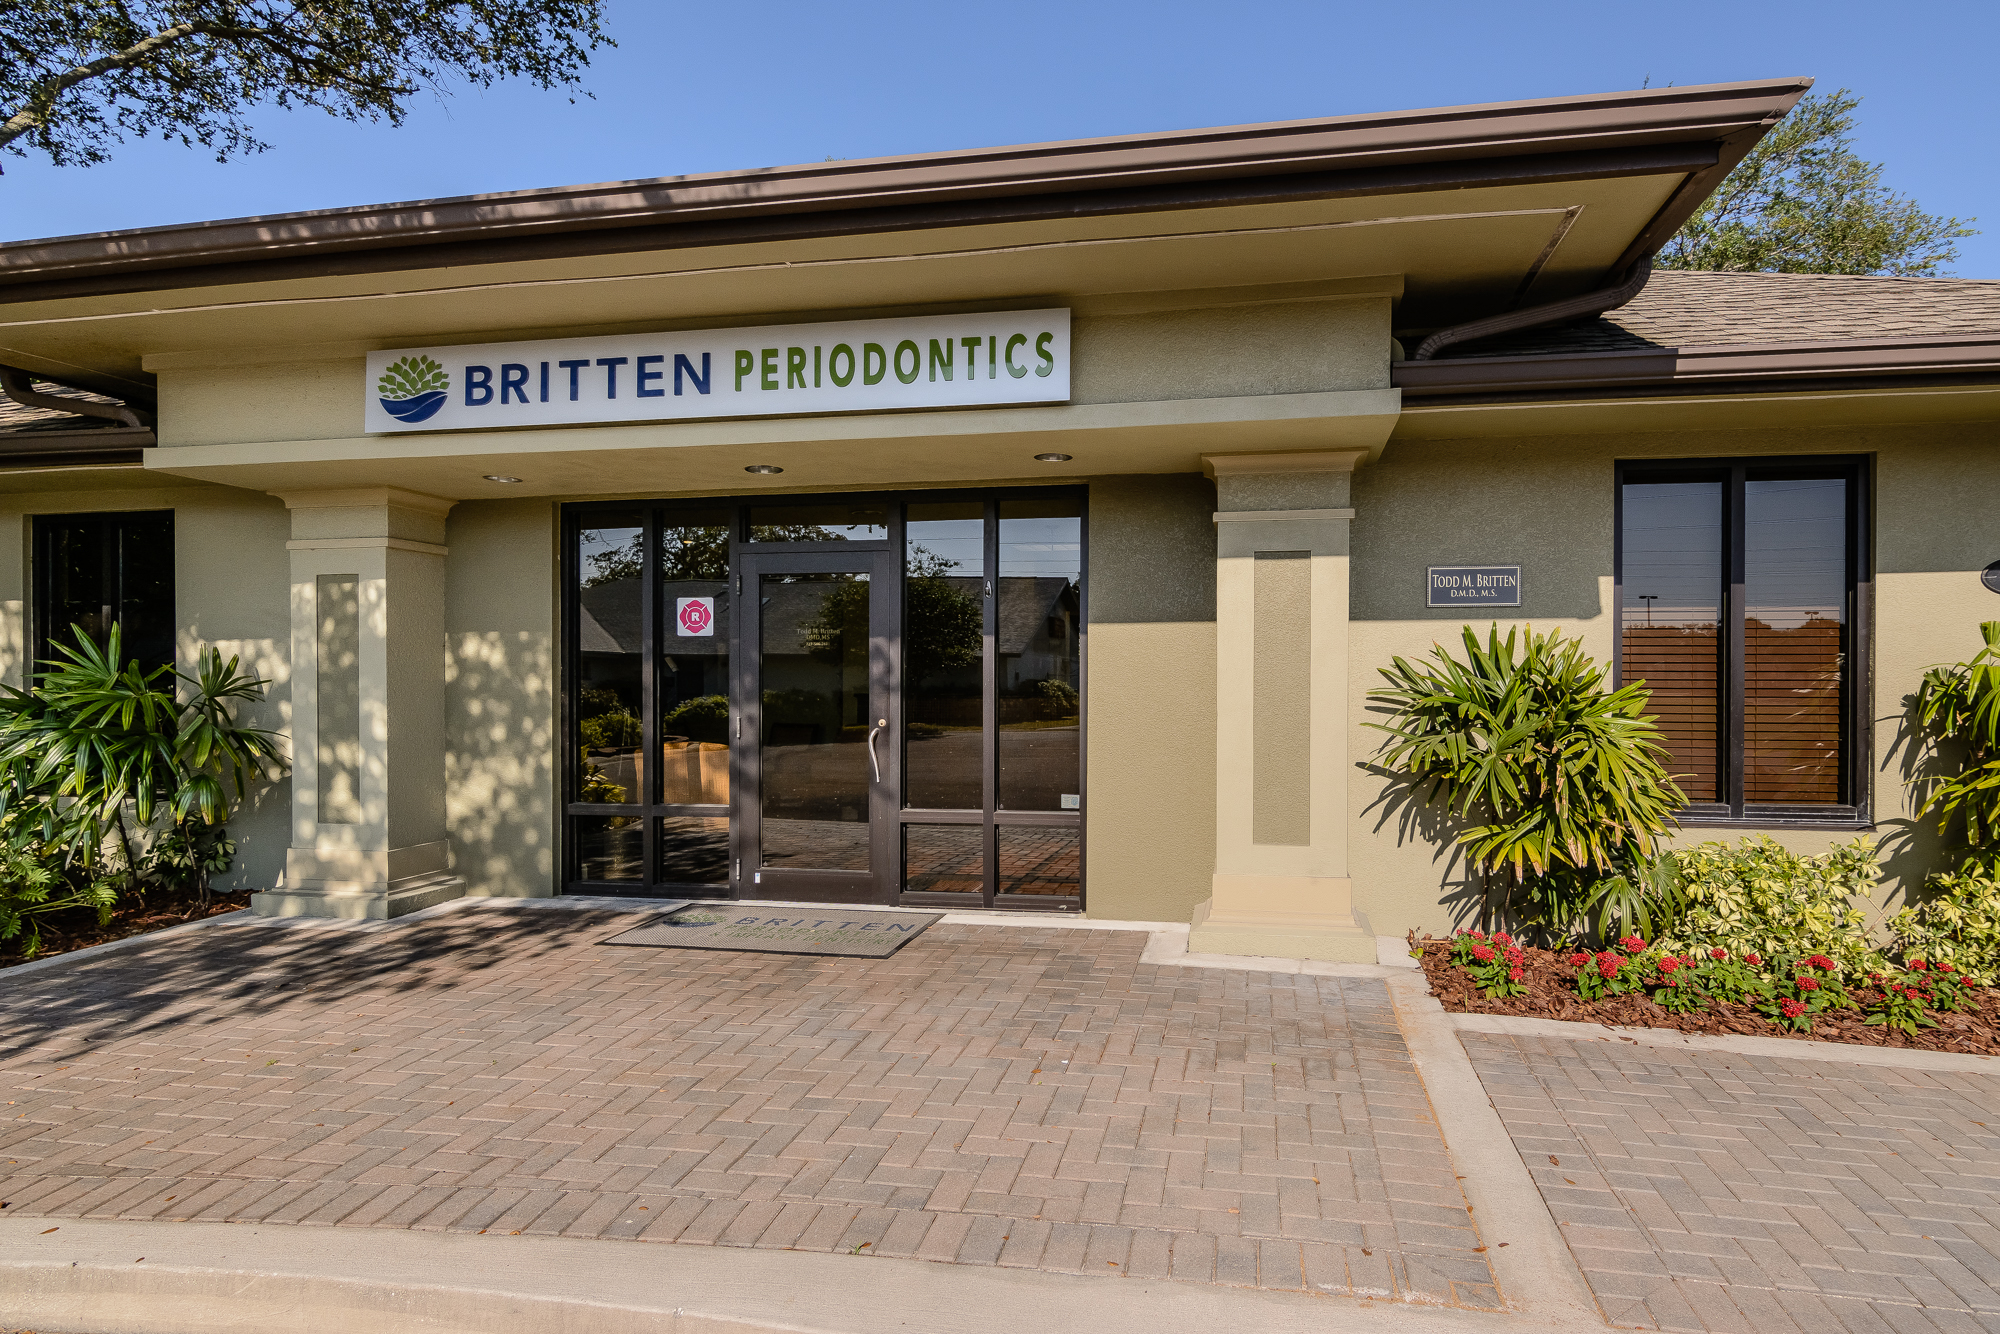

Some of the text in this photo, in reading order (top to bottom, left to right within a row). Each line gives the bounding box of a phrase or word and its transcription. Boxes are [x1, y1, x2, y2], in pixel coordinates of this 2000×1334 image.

[464, 331, 1055, 406] BRITTEN PERIODONTICS
[1432, 573, 1516, 588] TODD M. BRITTEN
[1481, 589, 1498, 597] M.S.
[691, 611, 701, 622] R
[723, 924, 902, 938] PERIODONTICS
[735, 916, 916, 932] BRITTEN
